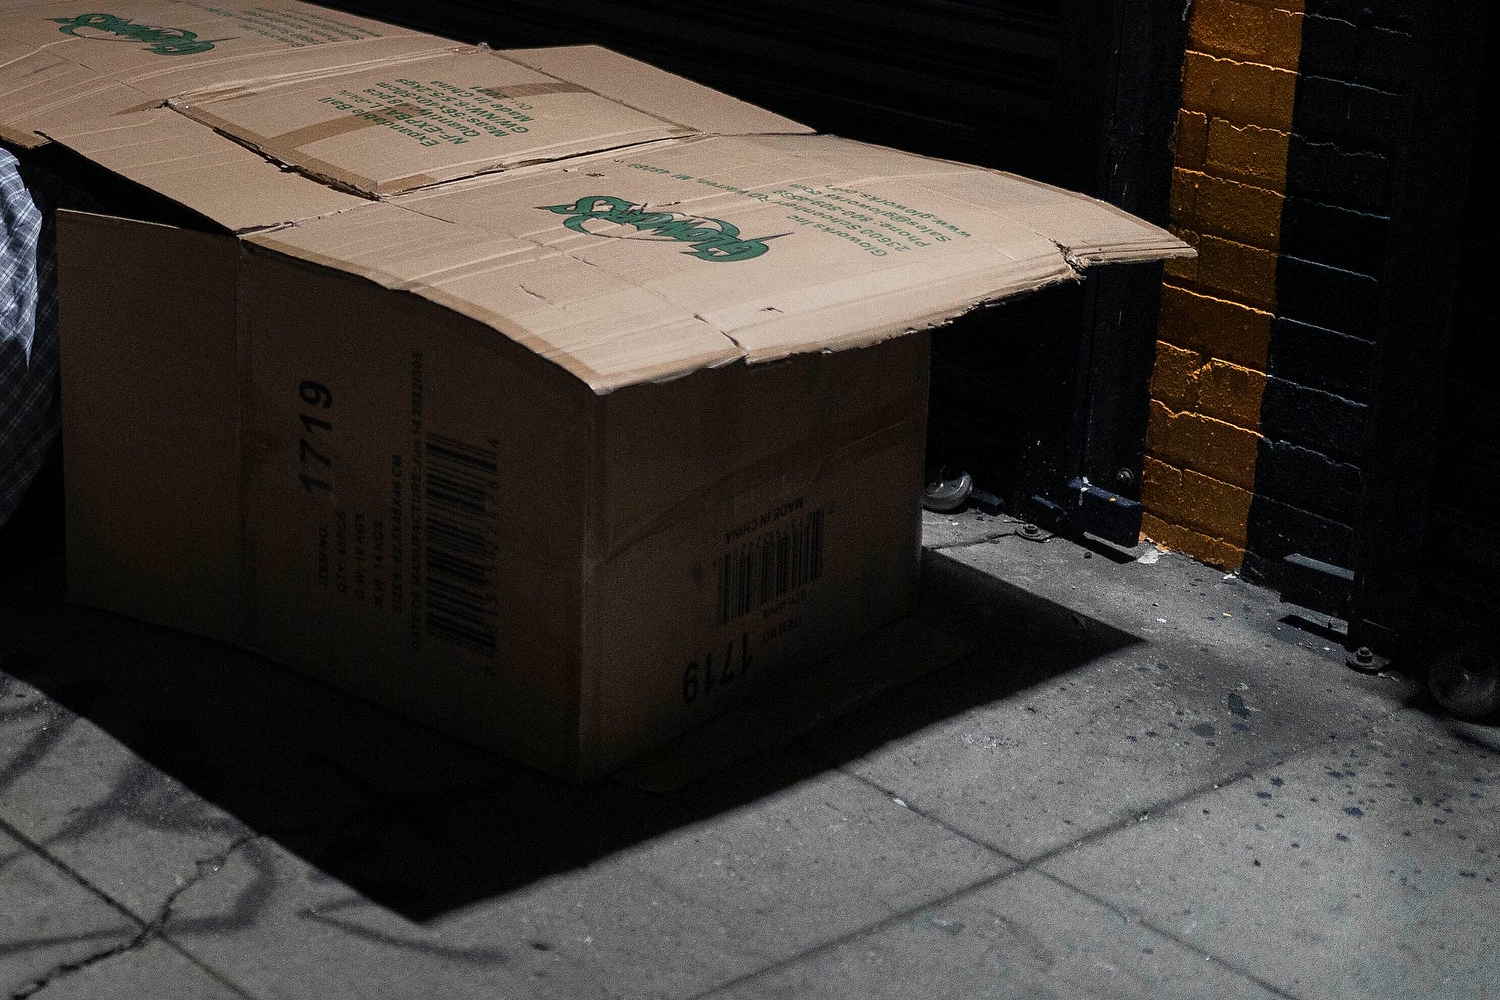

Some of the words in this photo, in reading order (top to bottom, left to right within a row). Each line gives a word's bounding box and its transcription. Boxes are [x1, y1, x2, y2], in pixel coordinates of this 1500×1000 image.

[317, 97, 353, 110] Ball
[430, 80, 474, 97] China
[351, 109, 441, 147] Expandable
[490, 104, 534, 122] Made
[812, 223, 888, 257] Gloworks
[873, 221, 932, 248] Phone:
[299, 379, 332, 494] 1719
[683, 633, 752, 705] 1719
